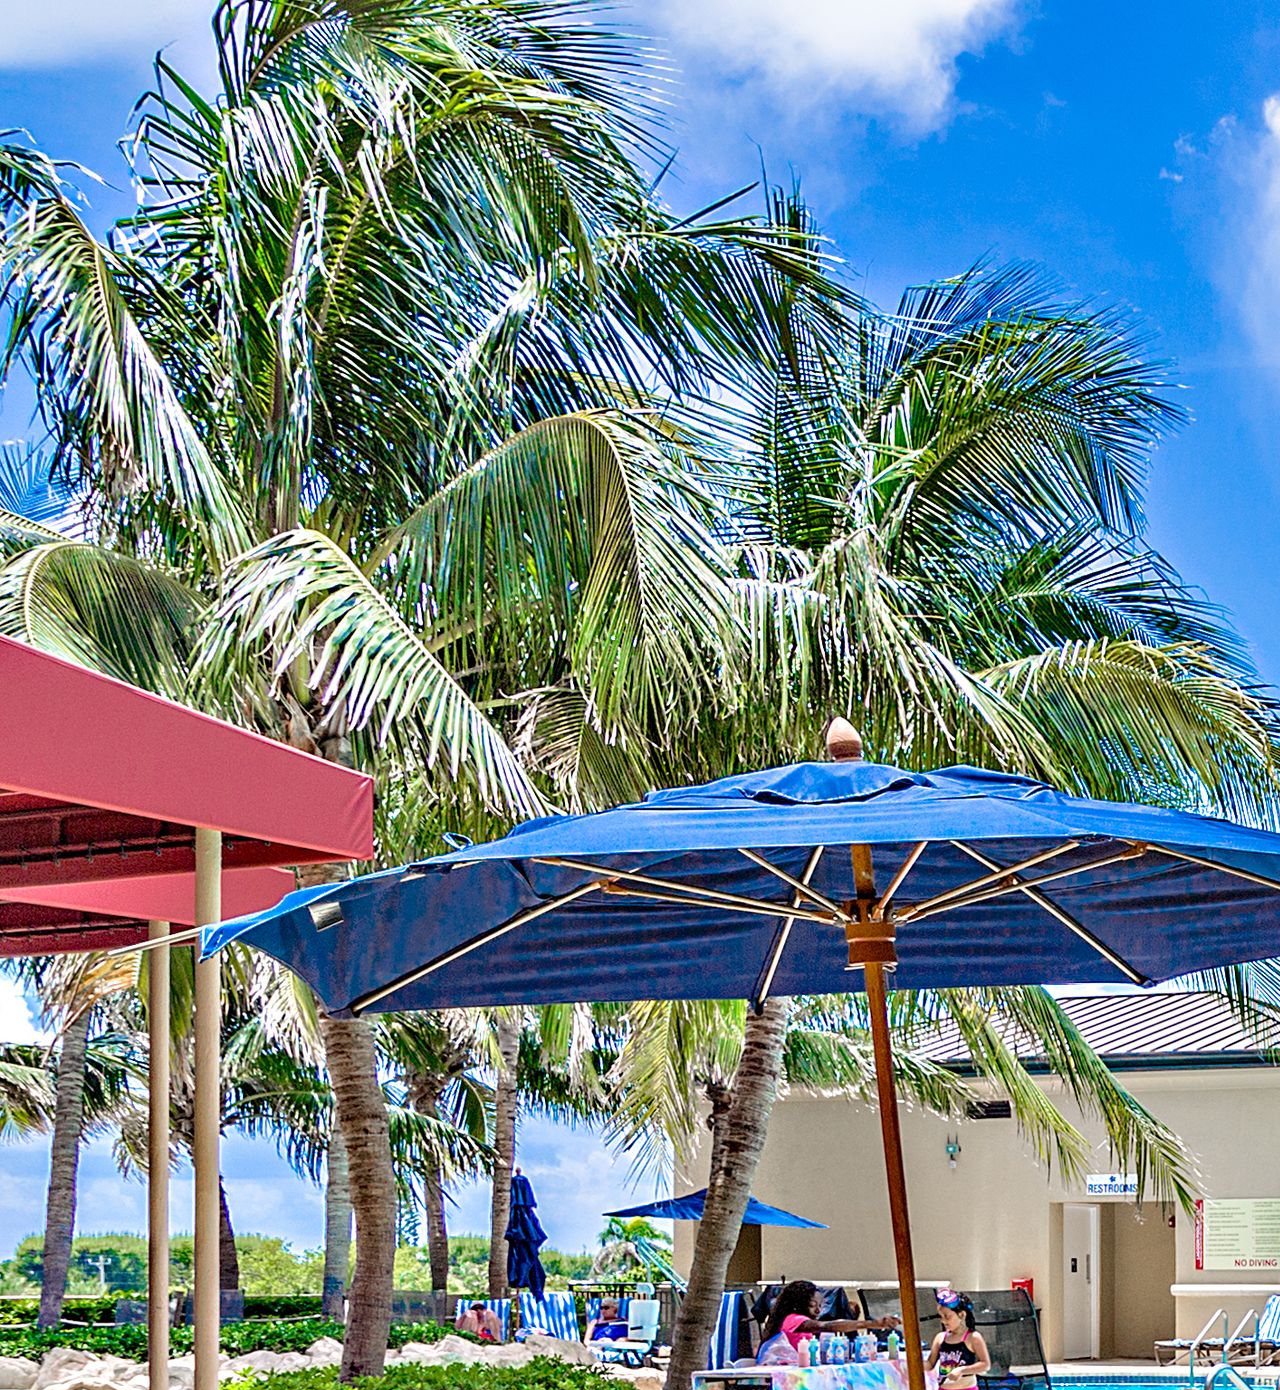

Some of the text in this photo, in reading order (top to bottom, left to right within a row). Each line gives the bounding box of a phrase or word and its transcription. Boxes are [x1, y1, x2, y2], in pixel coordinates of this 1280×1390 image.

[1088, 1184, 1138, 1193] RESTROOMS
[1234, 1259, 1278, 1267] NO DIVING
